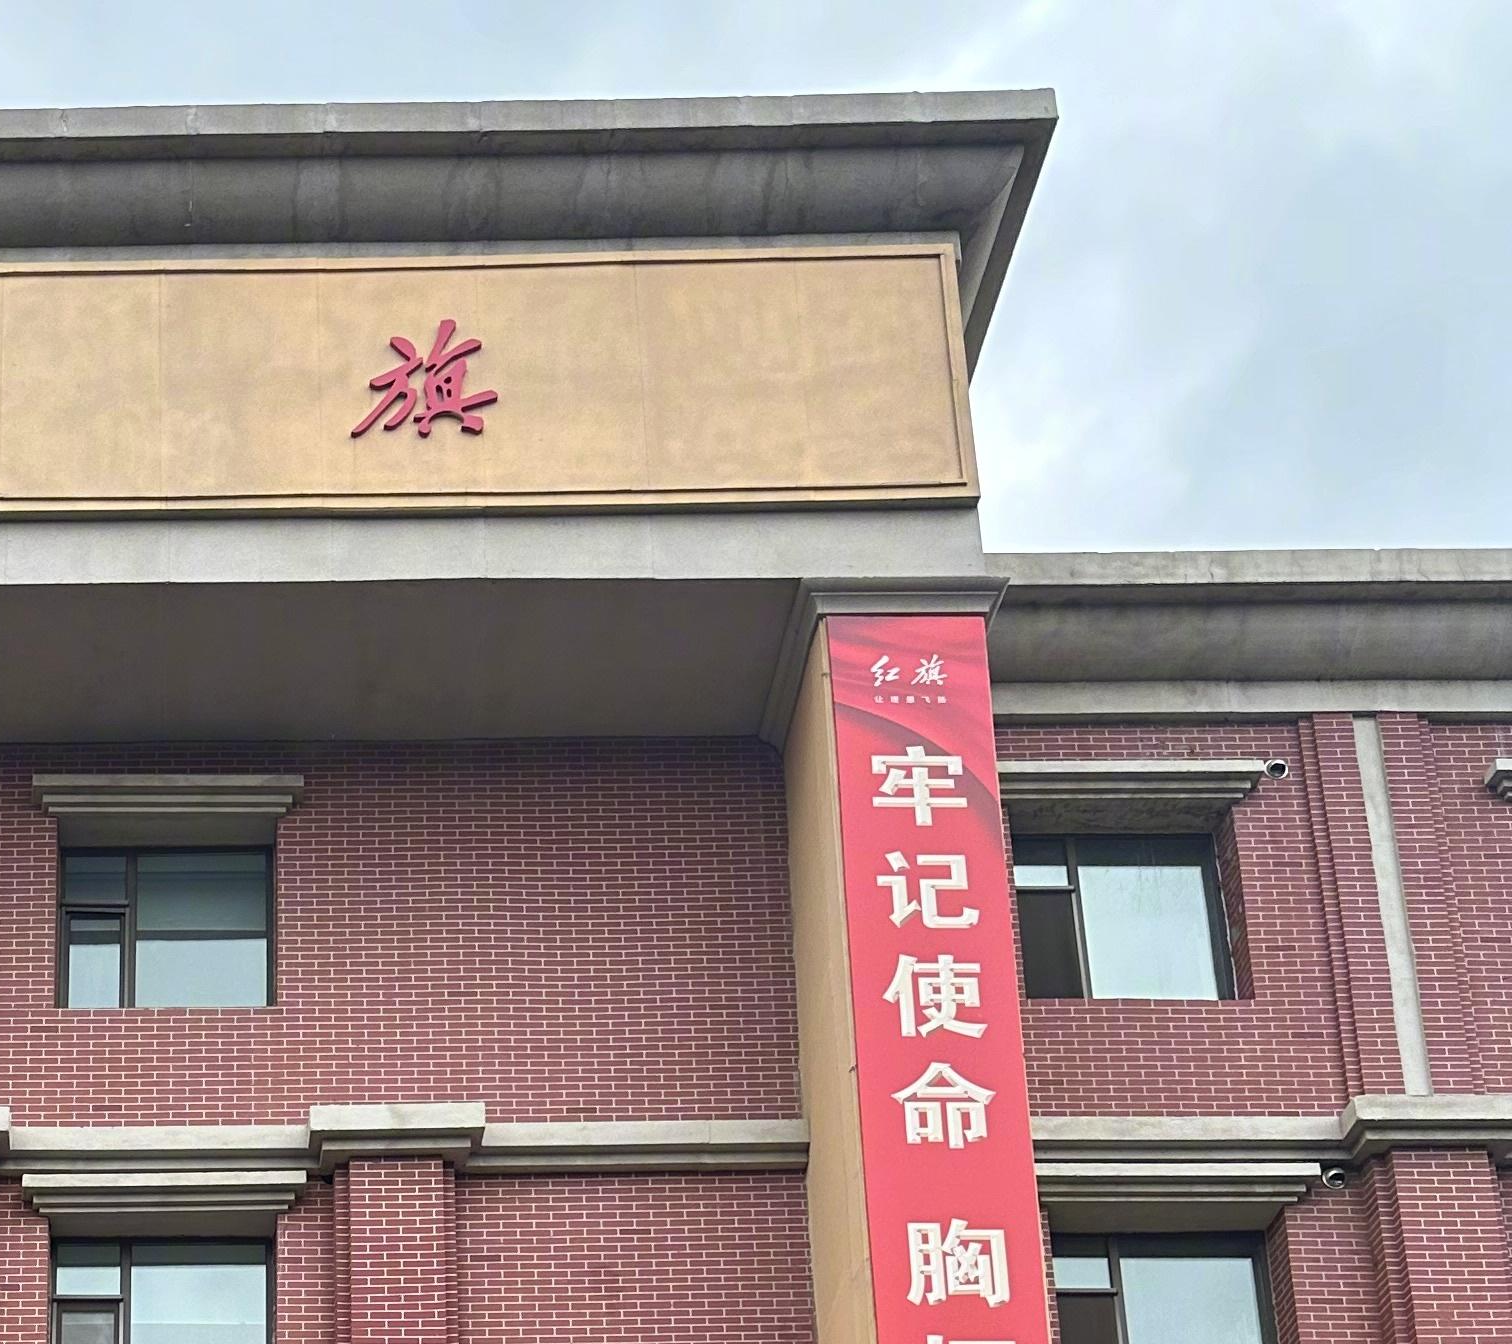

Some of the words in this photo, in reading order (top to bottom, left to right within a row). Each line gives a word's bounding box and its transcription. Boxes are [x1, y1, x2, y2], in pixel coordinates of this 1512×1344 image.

[870, 653, 948, 687] 红旗
[870, 745, 997, 1150] 牢记使命
